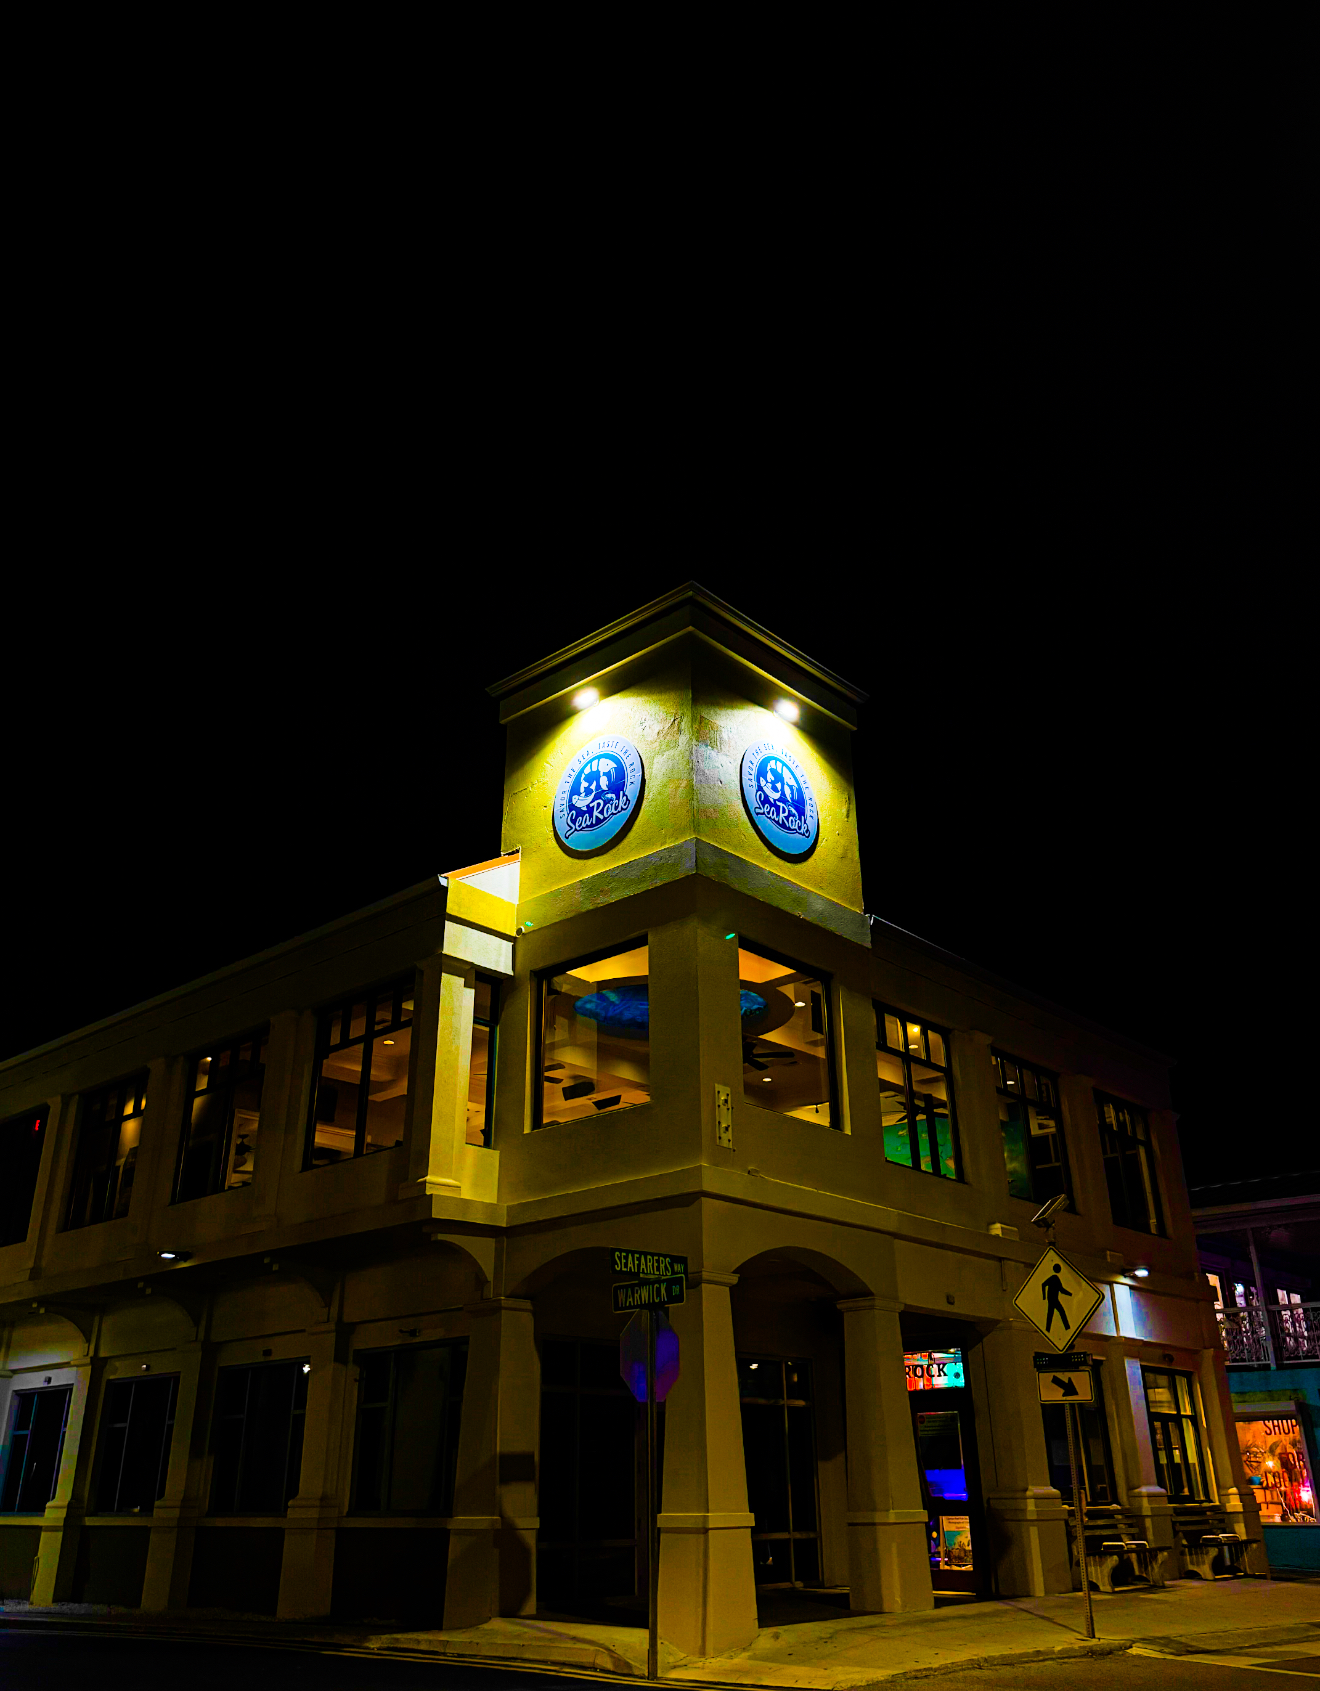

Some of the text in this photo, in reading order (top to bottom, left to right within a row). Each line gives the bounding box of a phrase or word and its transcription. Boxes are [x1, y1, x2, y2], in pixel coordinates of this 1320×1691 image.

[628, 762, 636, 786] ROCK
[614, 1251, 685, 1276] SEAFARERS WAY
[617, 1281, 680, 1307] WARWICK DR
[1263, 1419, 1298, 1436] SHOP
